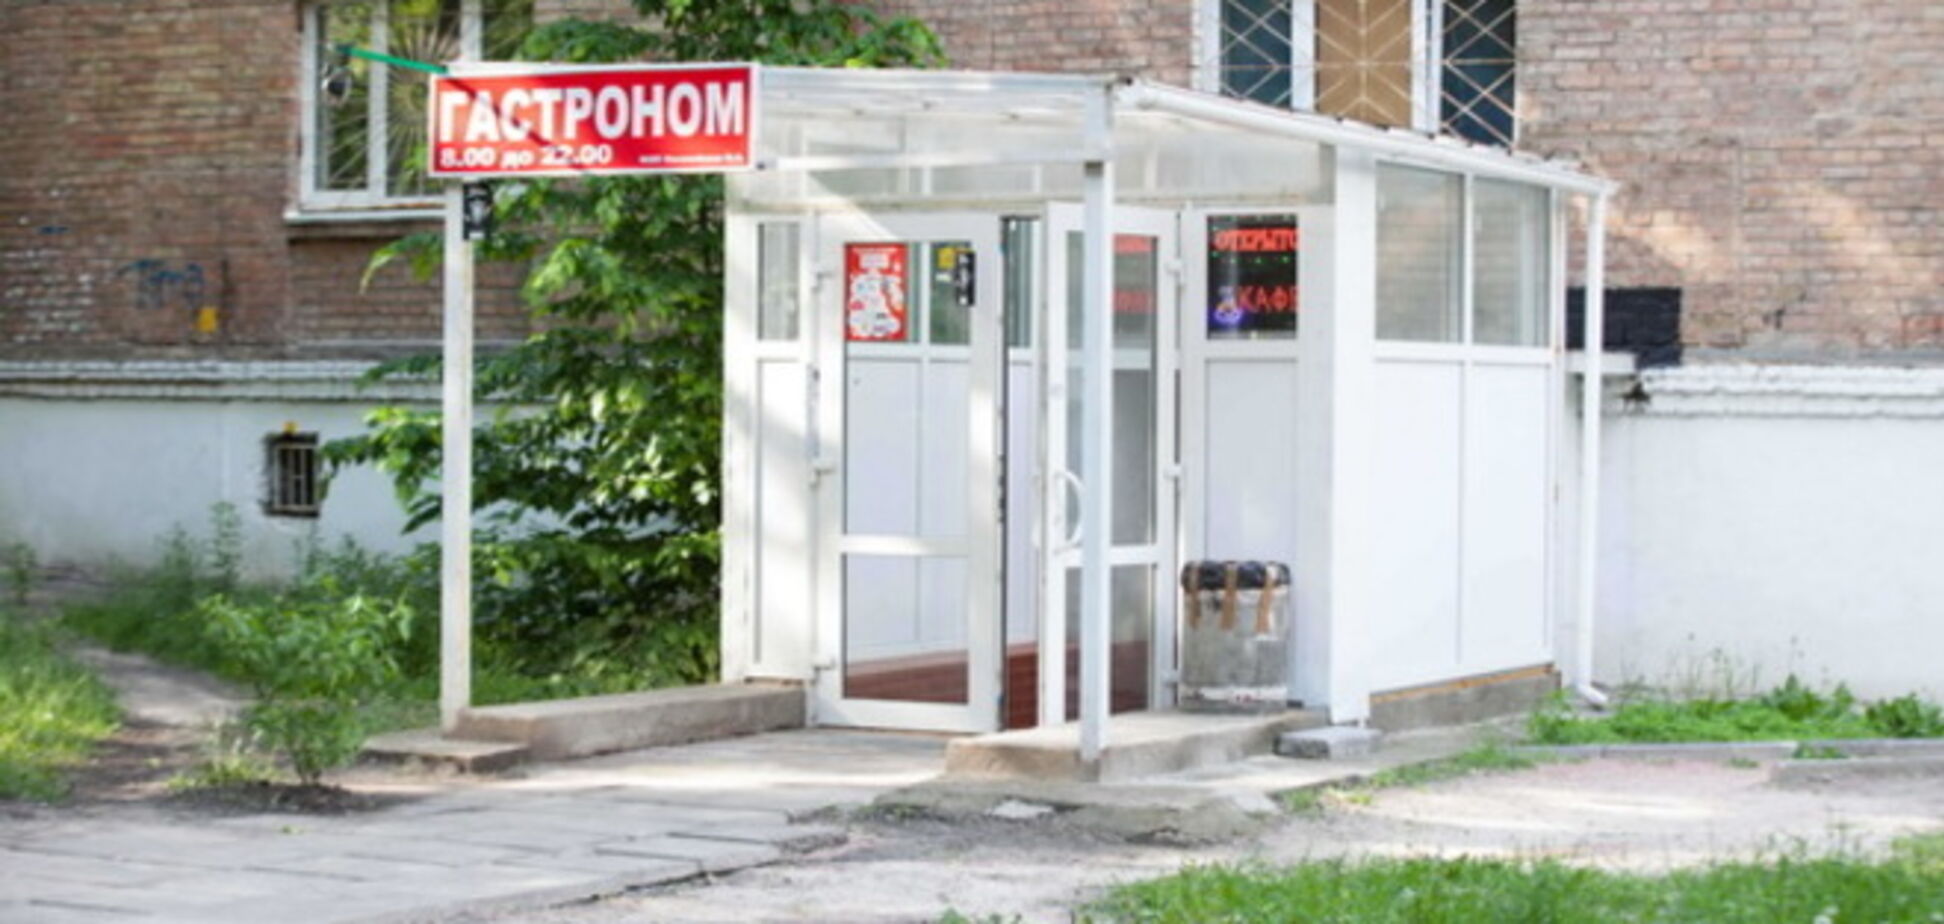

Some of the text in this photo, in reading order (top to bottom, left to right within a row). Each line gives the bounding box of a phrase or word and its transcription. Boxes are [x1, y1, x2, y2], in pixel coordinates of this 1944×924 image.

[438, 81, 744, 143] ГАСТРОНОМ
[440, 144, 612, 169] 8.00 до 22.00
